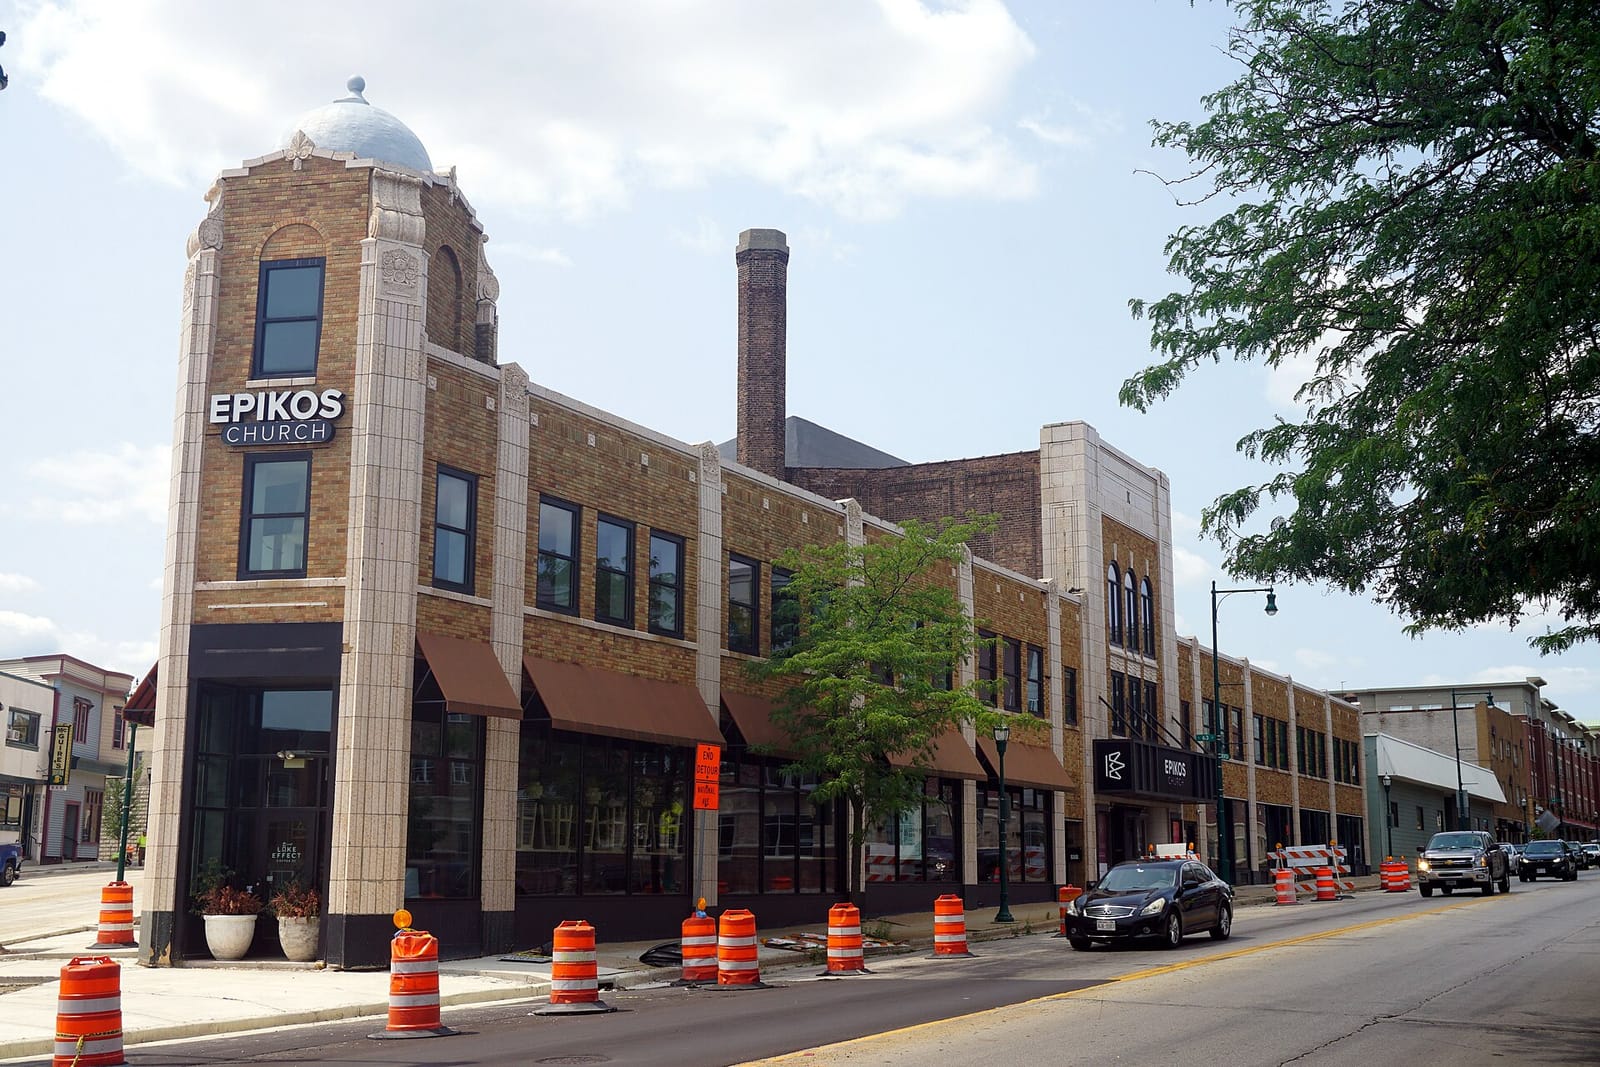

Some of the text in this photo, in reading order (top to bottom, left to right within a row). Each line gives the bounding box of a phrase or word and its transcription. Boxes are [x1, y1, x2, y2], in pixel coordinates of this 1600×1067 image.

[209, 388, 343, 424] EPIKOS
[226, 423, 326, 443] CHURCH
[703, 750, 714, 761] END
[696, 764, 719, 776] DETOUR
[1164, 759, 1187, 777] EPIKOS
